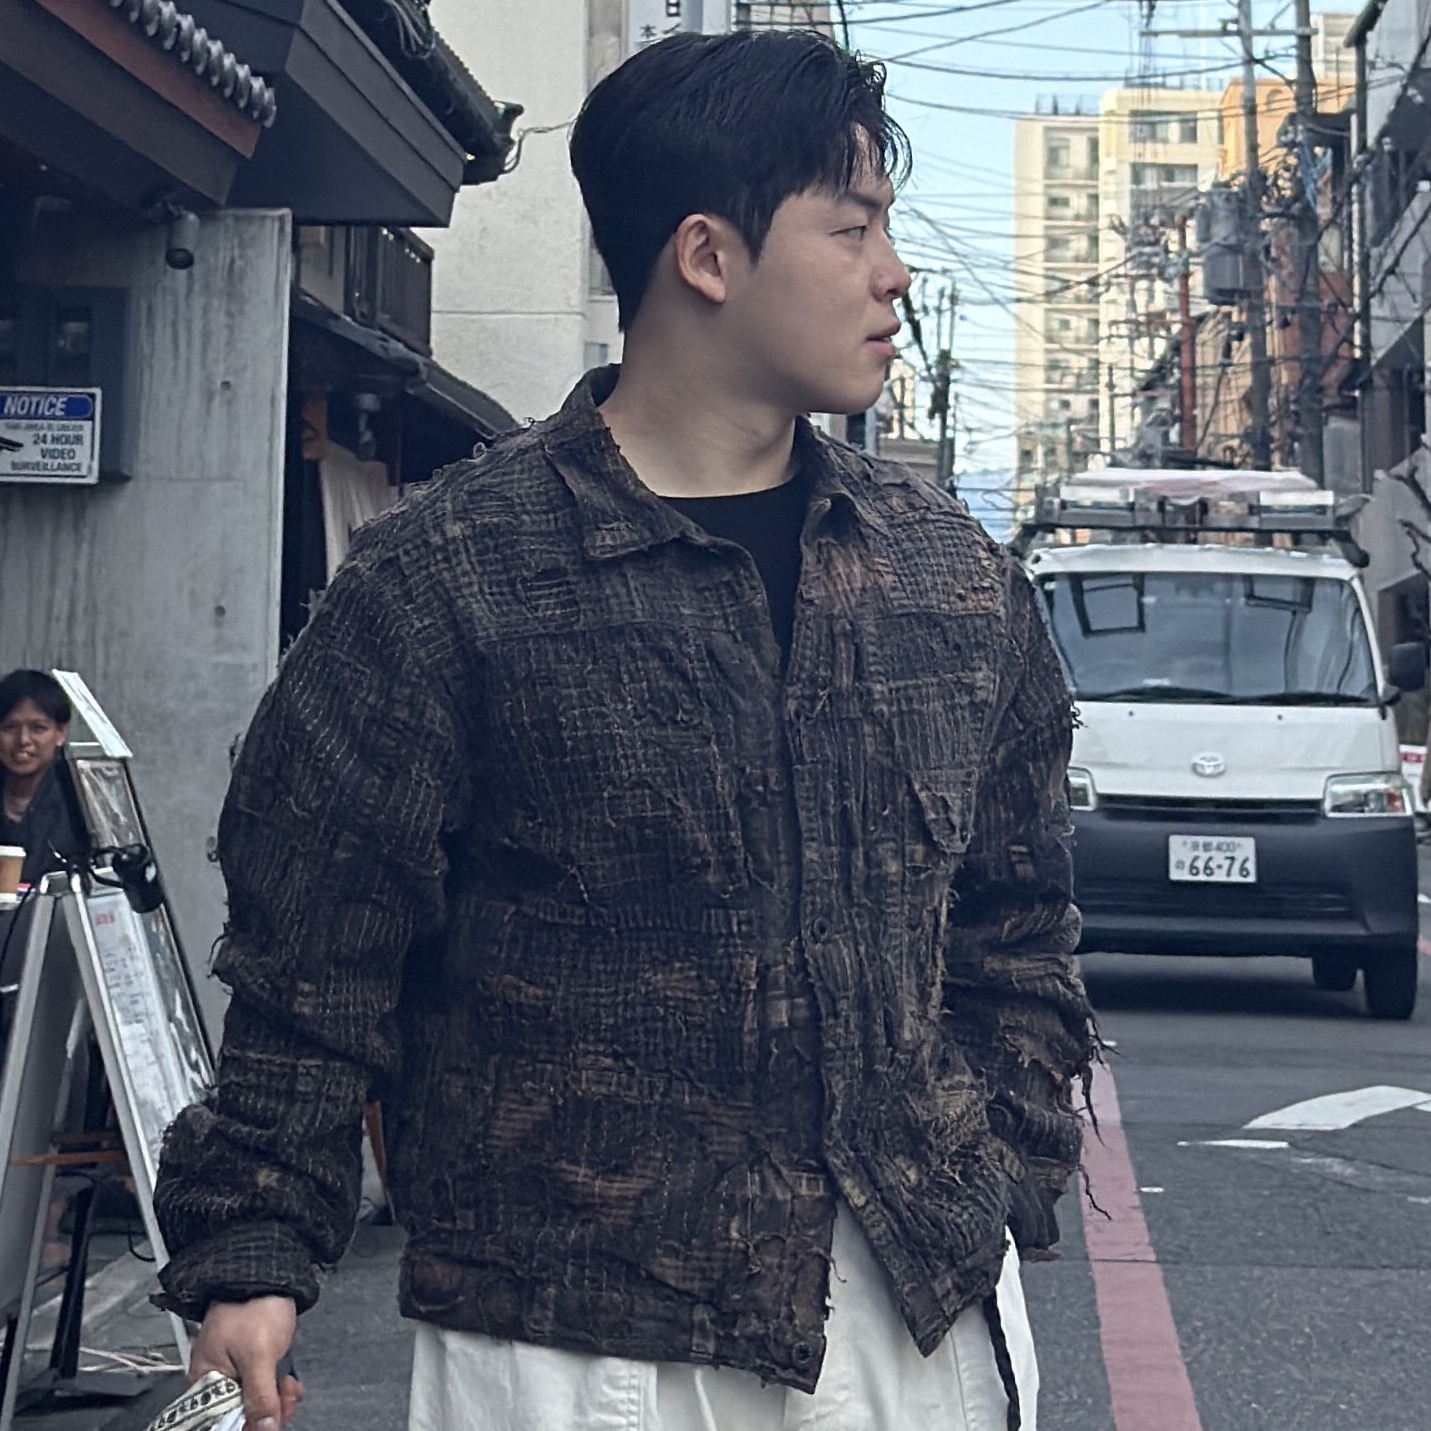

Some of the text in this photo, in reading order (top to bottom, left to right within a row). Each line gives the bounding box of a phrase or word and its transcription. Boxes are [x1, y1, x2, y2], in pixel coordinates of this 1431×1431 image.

[3, 396, 68, 415] NOTICE
[32, 433, 84, 445] 24 HOUR
[40, 448, 76, 460] VIDEO
[1189, 855, 1251, 878] 66-76
